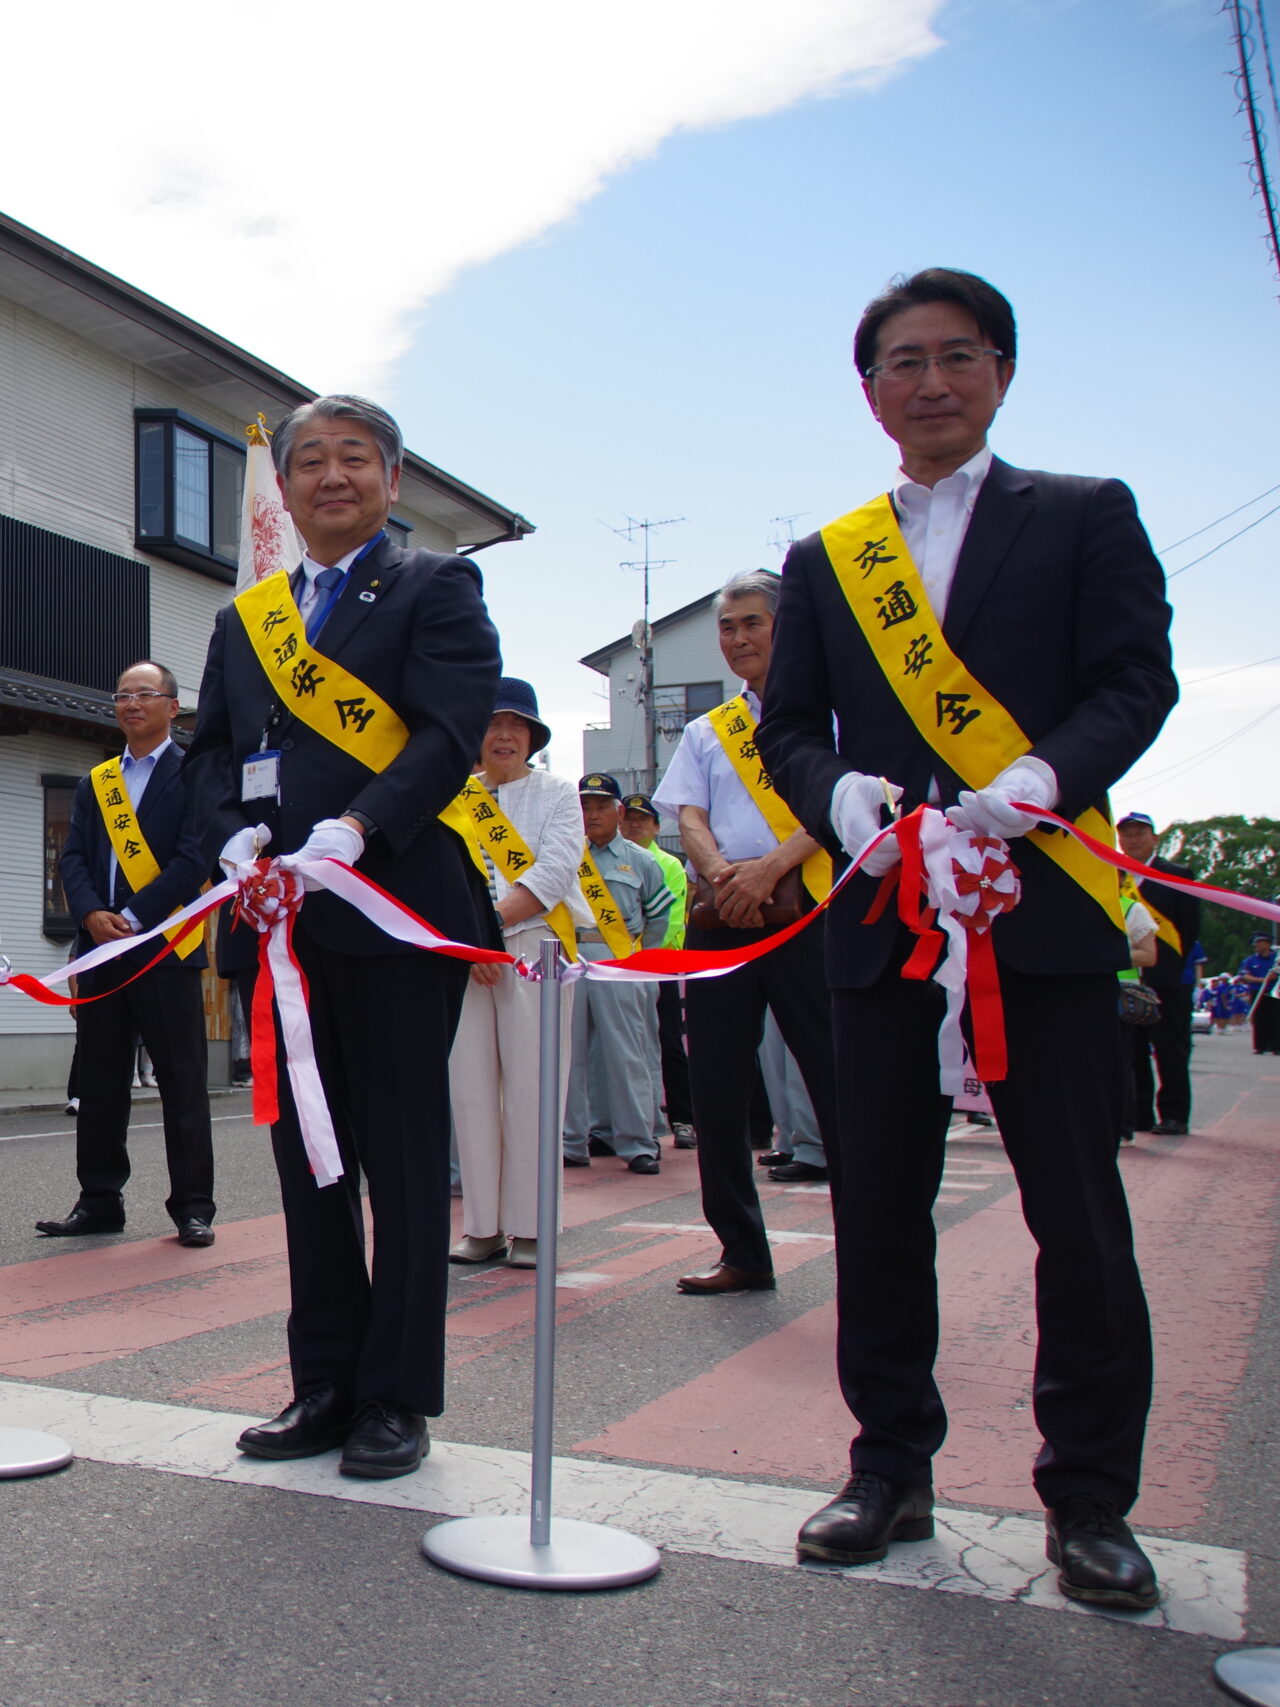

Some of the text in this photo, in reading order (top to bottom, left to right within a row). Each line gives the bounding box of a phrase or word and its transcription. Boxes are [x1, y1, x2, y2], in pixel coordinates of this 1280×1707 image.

[261, 603, 376, 734] 交通安全
[852, 536, 982, 735] 交通安全
[100, 766, 141, 859] 交通安全
